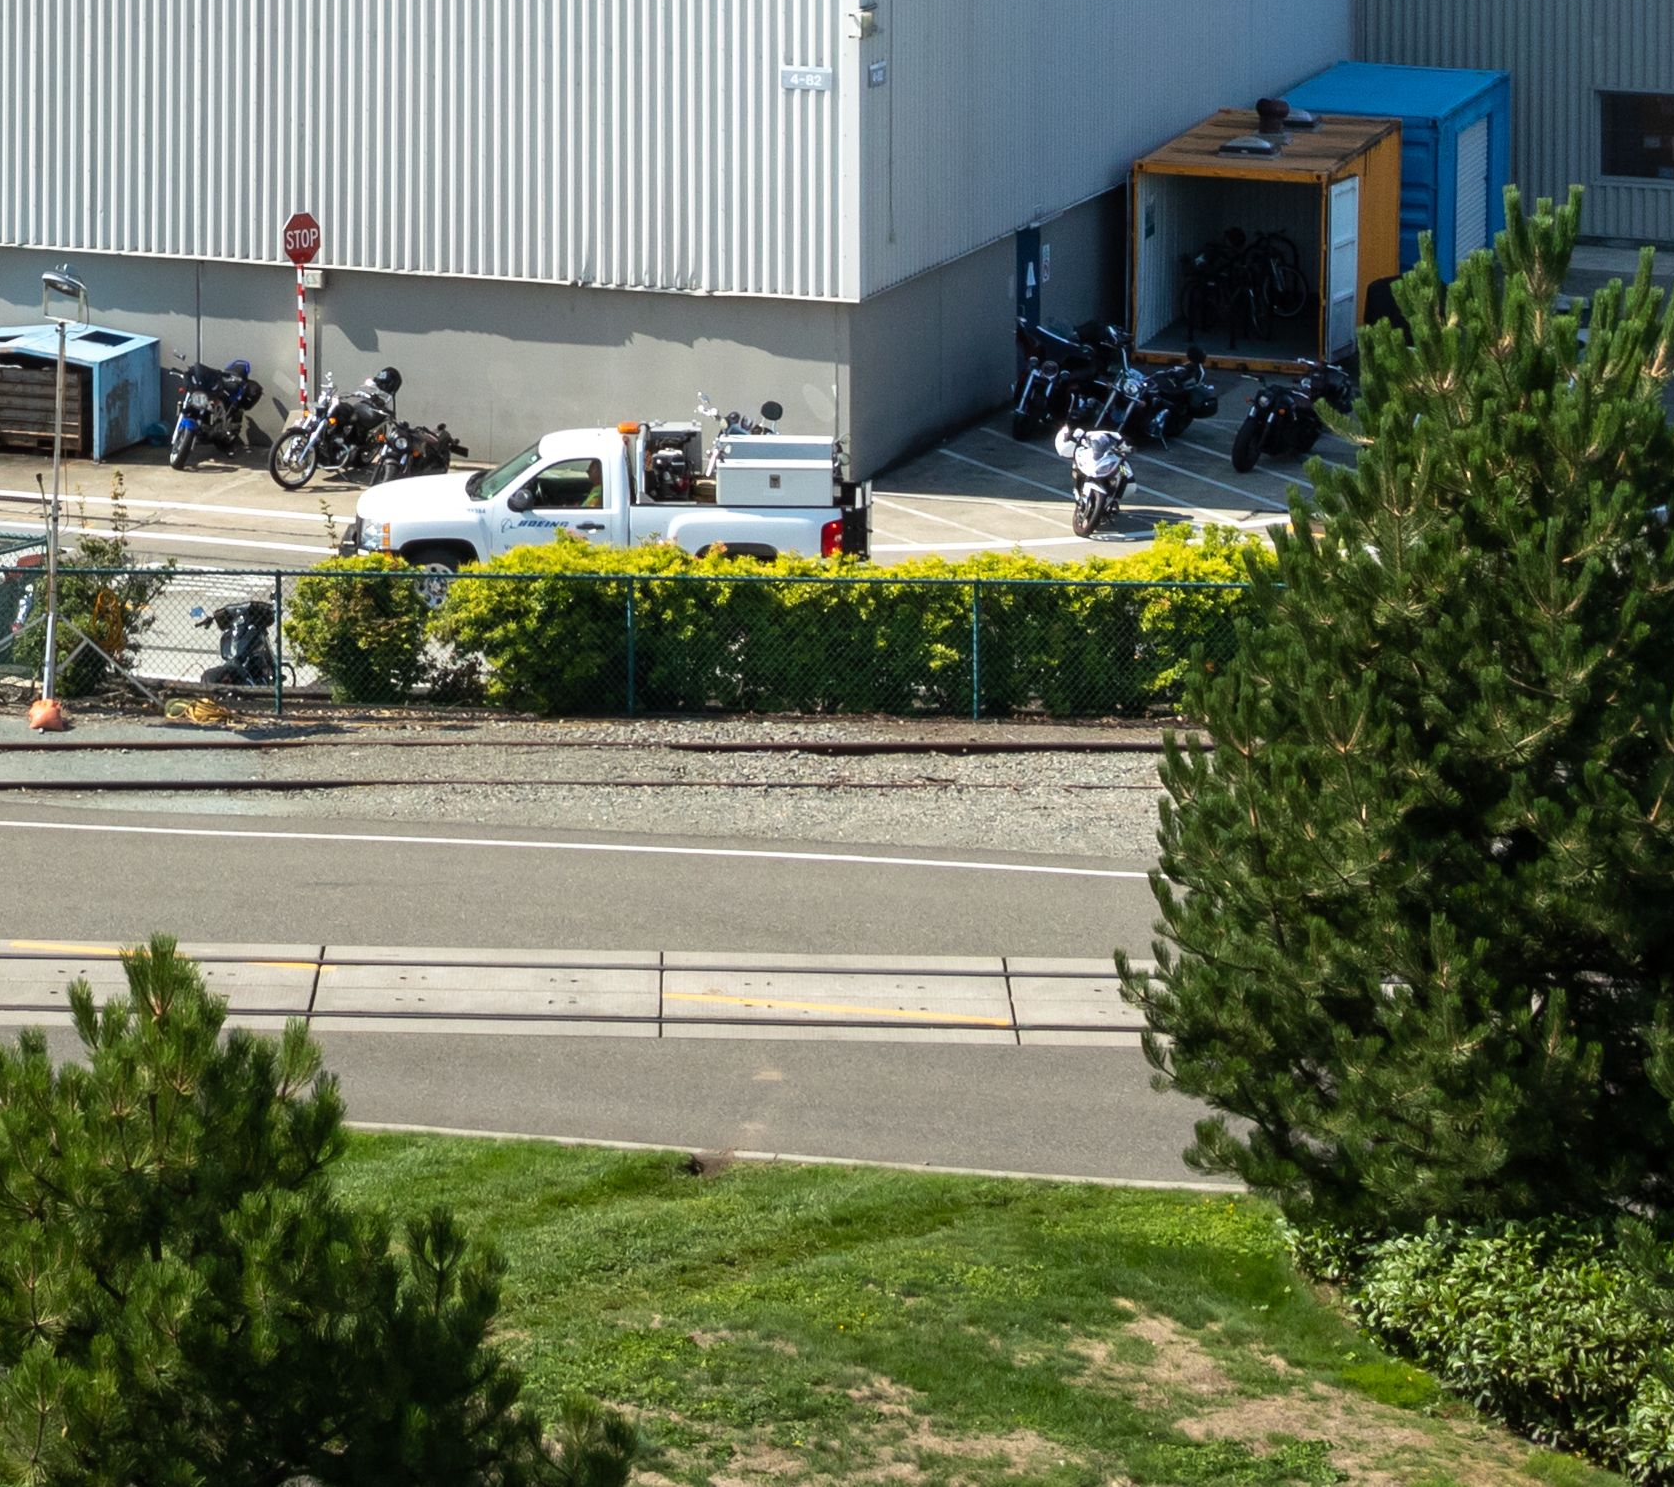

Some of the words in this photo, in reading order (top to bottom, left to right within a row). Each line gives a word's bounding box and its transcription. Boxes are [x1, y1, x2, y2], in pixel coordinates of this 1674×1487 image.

[790, 74, 822, 86] 4-82
[286, 228, 319, 250] STOP
[518, 519, 570, 528] BOEING
